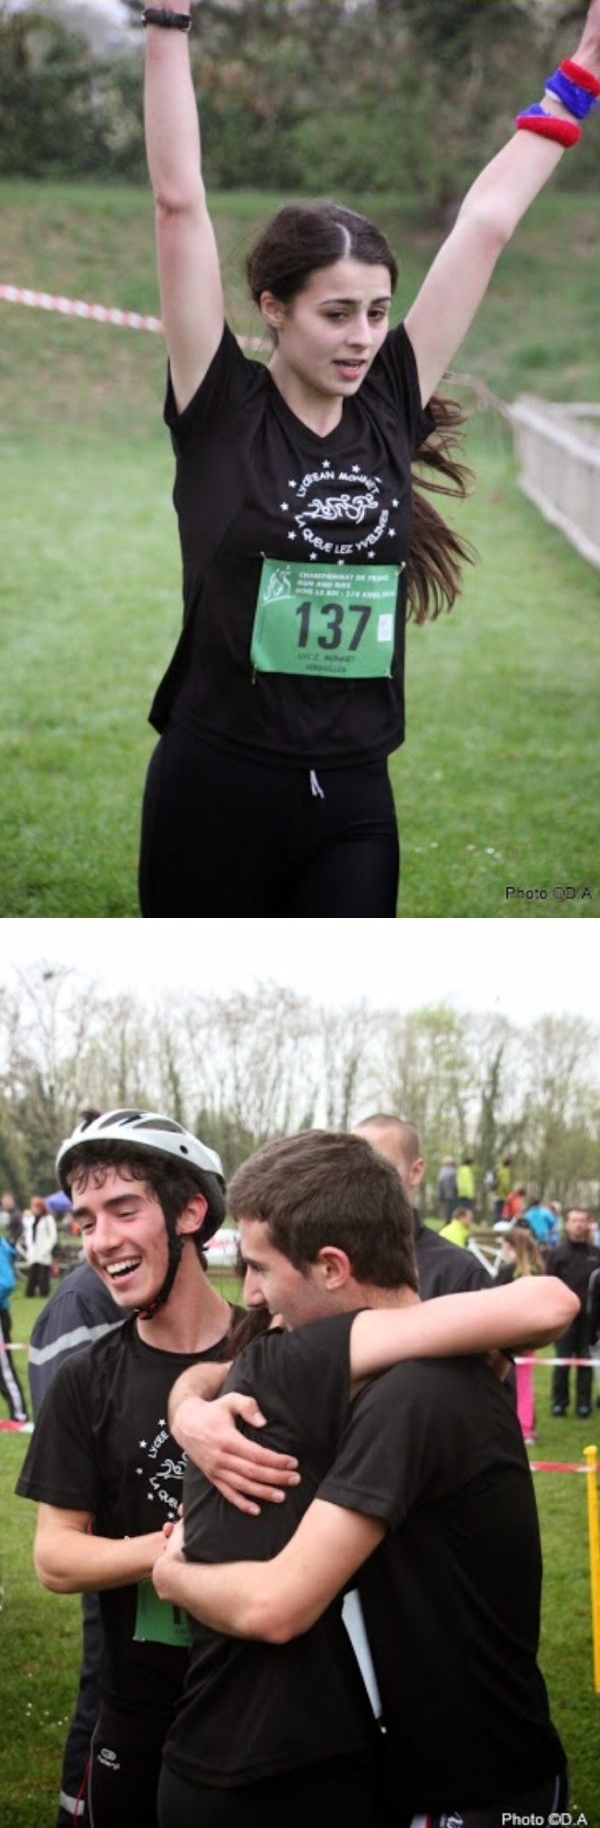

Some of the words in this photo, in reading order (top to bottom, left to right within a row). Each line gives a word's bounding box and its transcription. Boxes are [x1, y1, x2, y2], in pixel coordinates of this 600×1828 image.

[338, 471, 380, 495] MONNET
[295, 514, 304, 528] LA
[302, 528, 334, 553] QUEUE
[334, 544, 354, 554] LEZ
[355, 509, 390, 551] YVELINES
[296, 601, 372, 652] 137
[148, 1429, 169, 1459] LYCEE
[149, 1476, 160, 1490] LA
[158, 1489, 179, 1508] QUE
